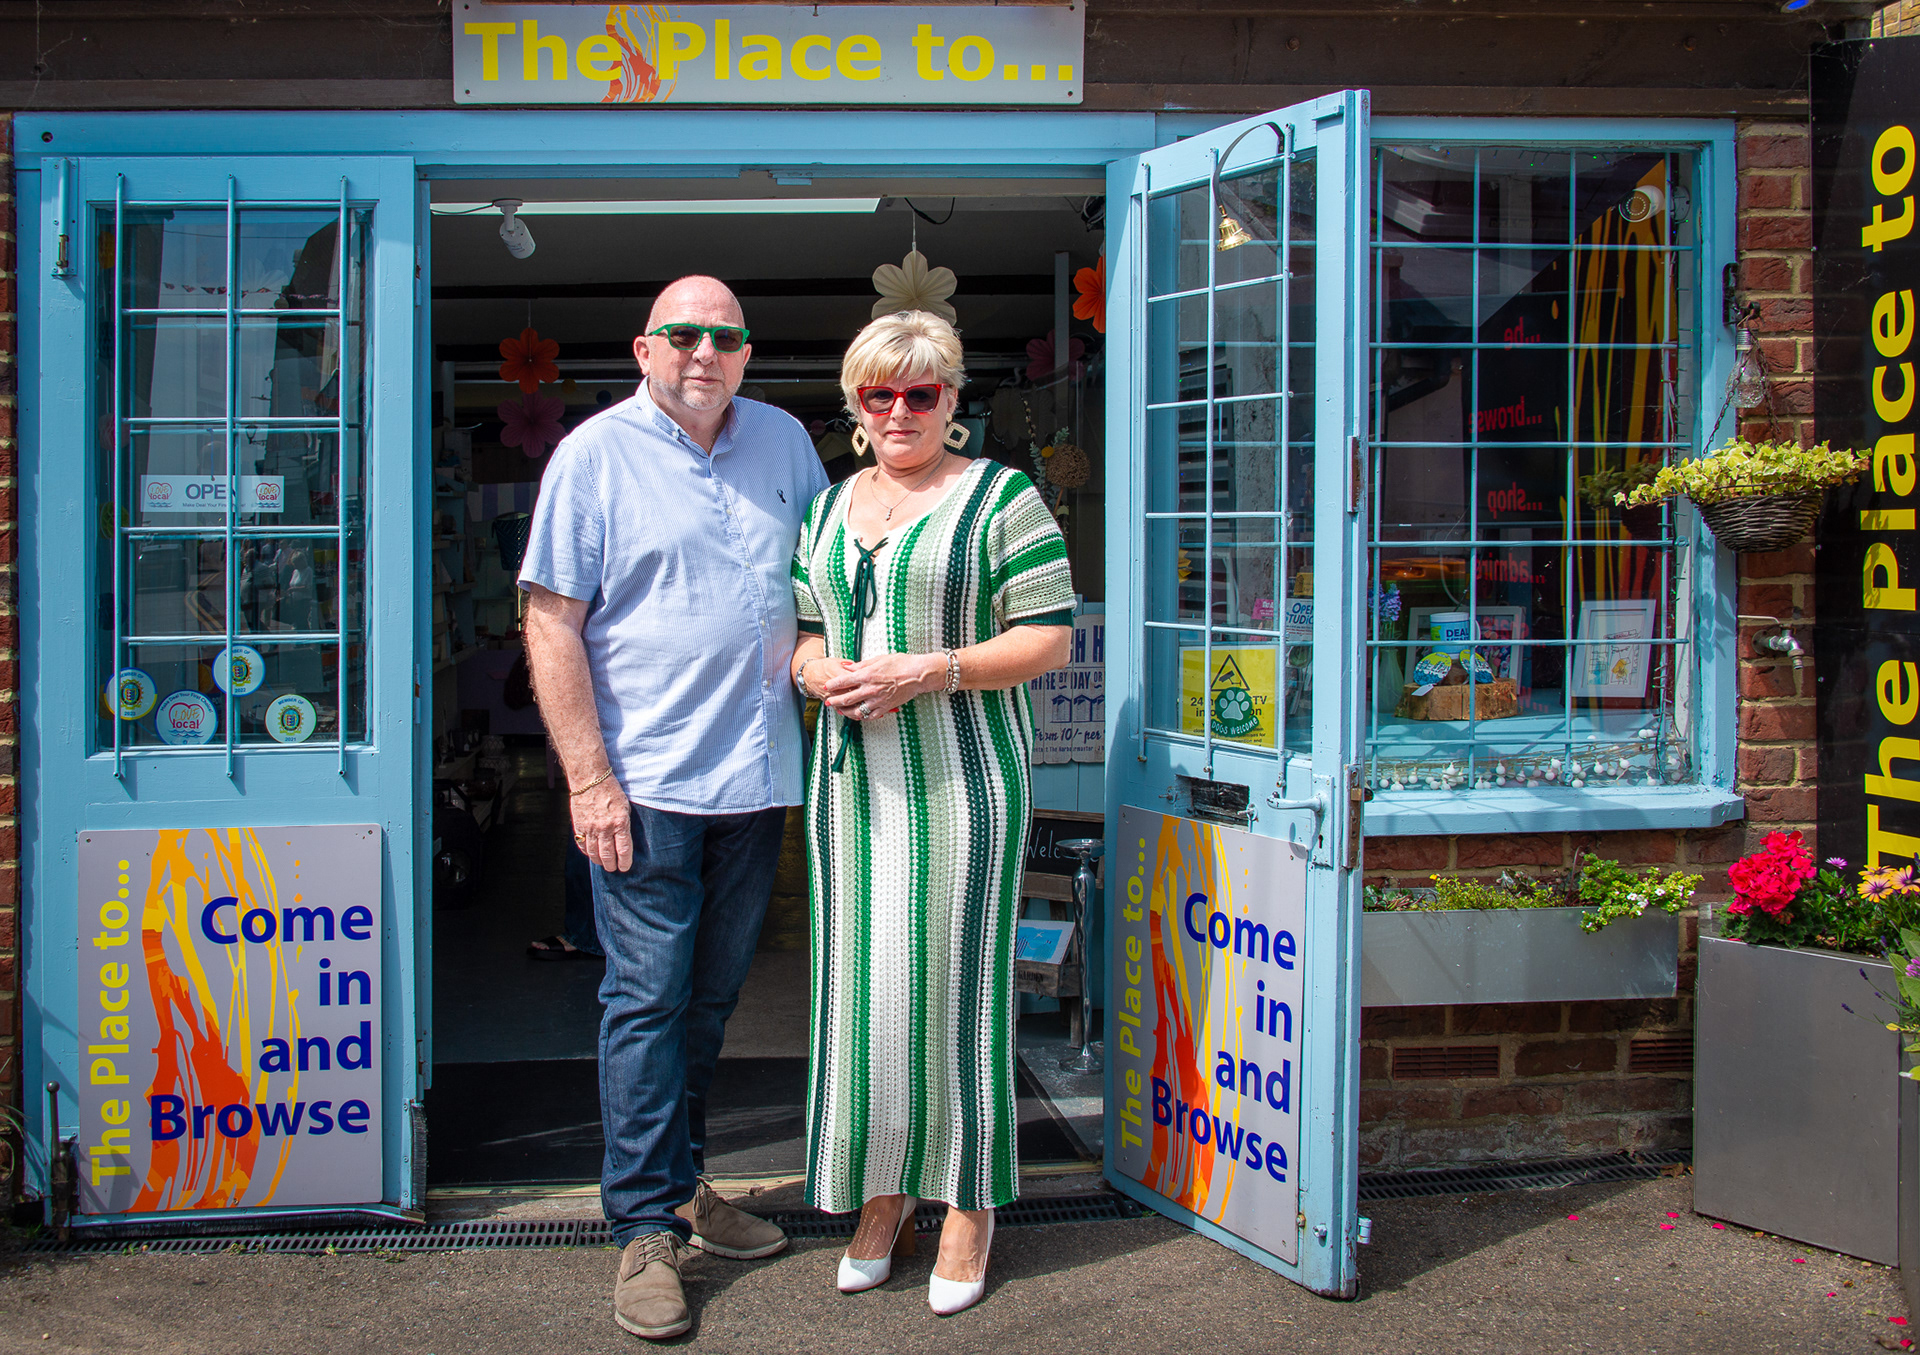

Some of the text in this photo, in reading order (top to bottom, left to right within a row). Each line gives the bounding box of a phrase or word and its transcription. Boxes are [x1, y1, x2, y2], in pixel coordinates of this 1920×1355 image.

[464, 18, 1074, 82] The Place to...
[185, 483, 236, 500] OPE
[1861, 125, 1920, 872] The Place to
[1446, 628, 1470, 638] DEAL
[1059, 671, 1068, 682] BY
[1070, 671, 1091, 689] DAY
[172, 719, 200, 729] local
[174, 707, 200, 721] LOVE
[200, 897, 374, 944] Come
[1183, 891, 1297, 971] Come
[318, 958, 372, 1007] in
[1118, 933, 1143, 1056] Place
[1255, 979, 1293, 1043] in
[88, 961, 131, 1085] Place
[258, 1020, 373, 1073] and
[1121, 1063, 1144, 1149] The
[1215, 1048, 1292, 1115] and
[89, 1098, 131, 1185] The
[150, 1093, 371, 1142] Browse
[1152, 1076, 1289, 1184] Browse
